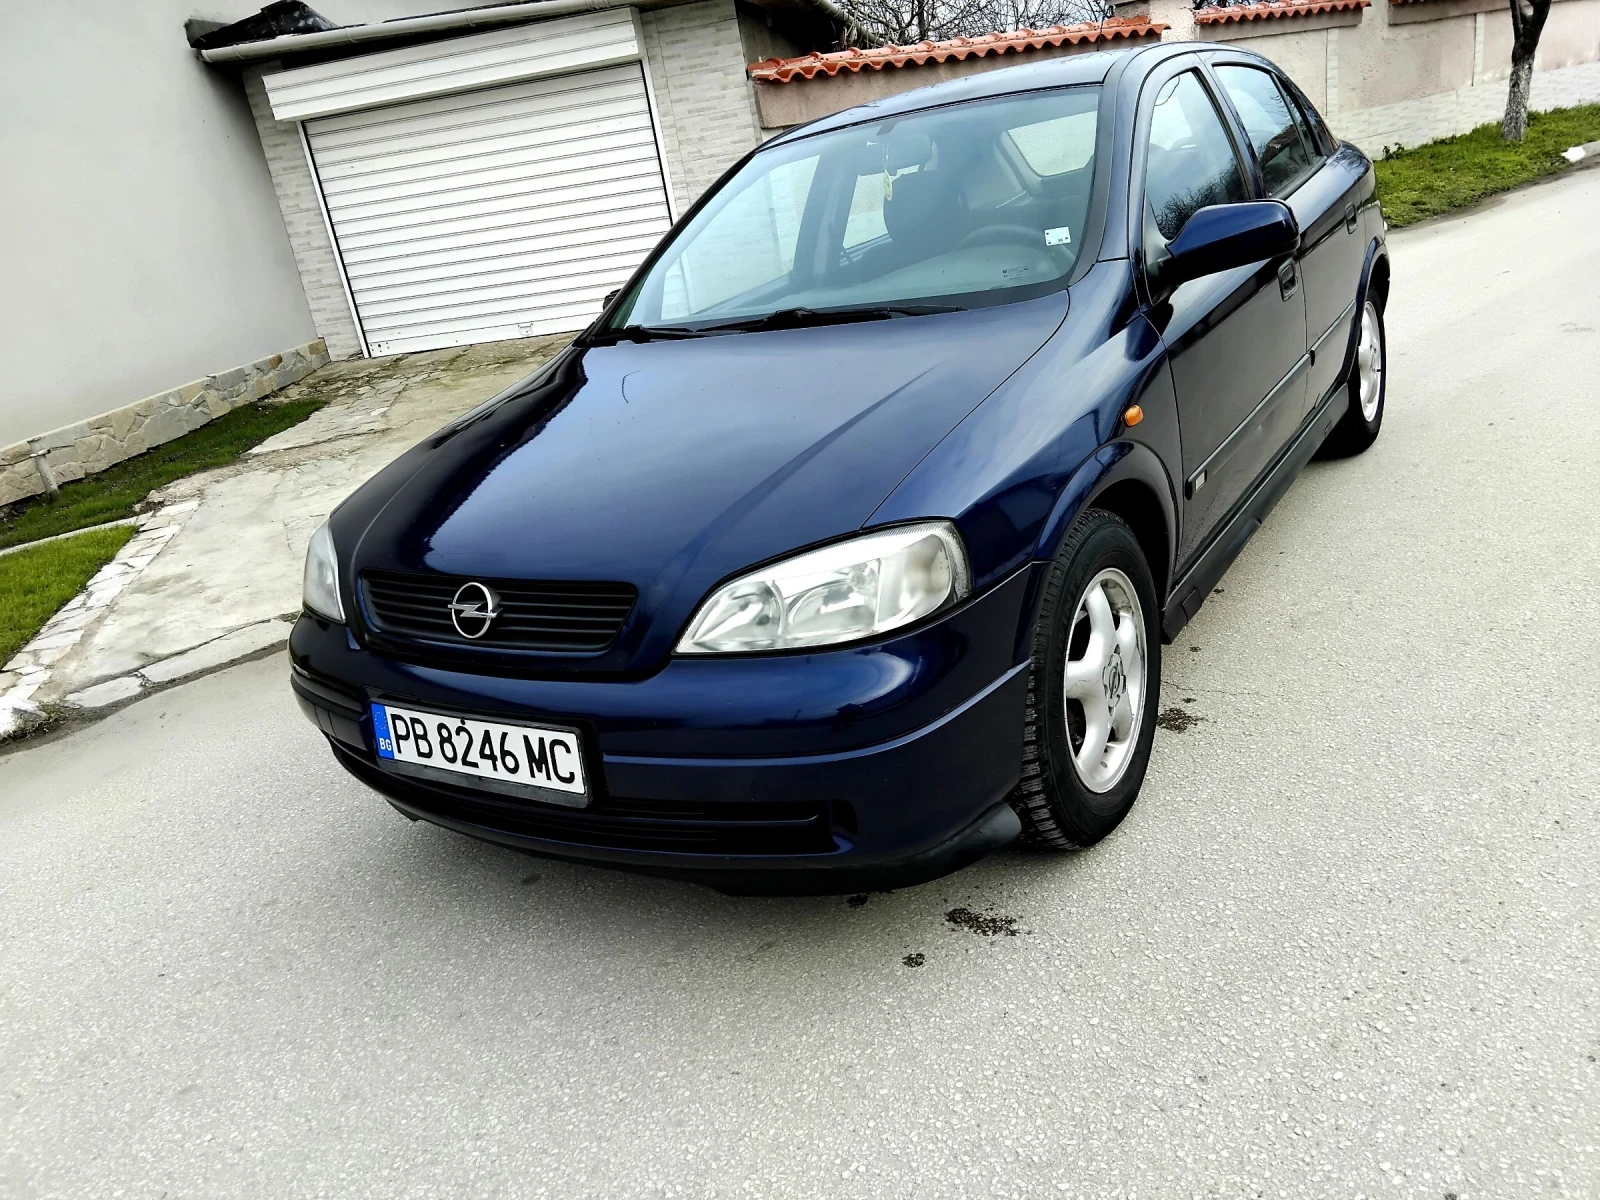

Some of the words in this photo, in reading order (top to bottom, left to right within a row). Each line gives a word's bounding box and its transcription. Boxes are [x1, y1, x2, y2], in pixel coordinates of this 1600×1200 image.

[379, 737, 392, 751] BG
[390, 713, 433, 759] PB
[437, 722, 520, 775] 8246
[523, 734, 575, 784] MC
